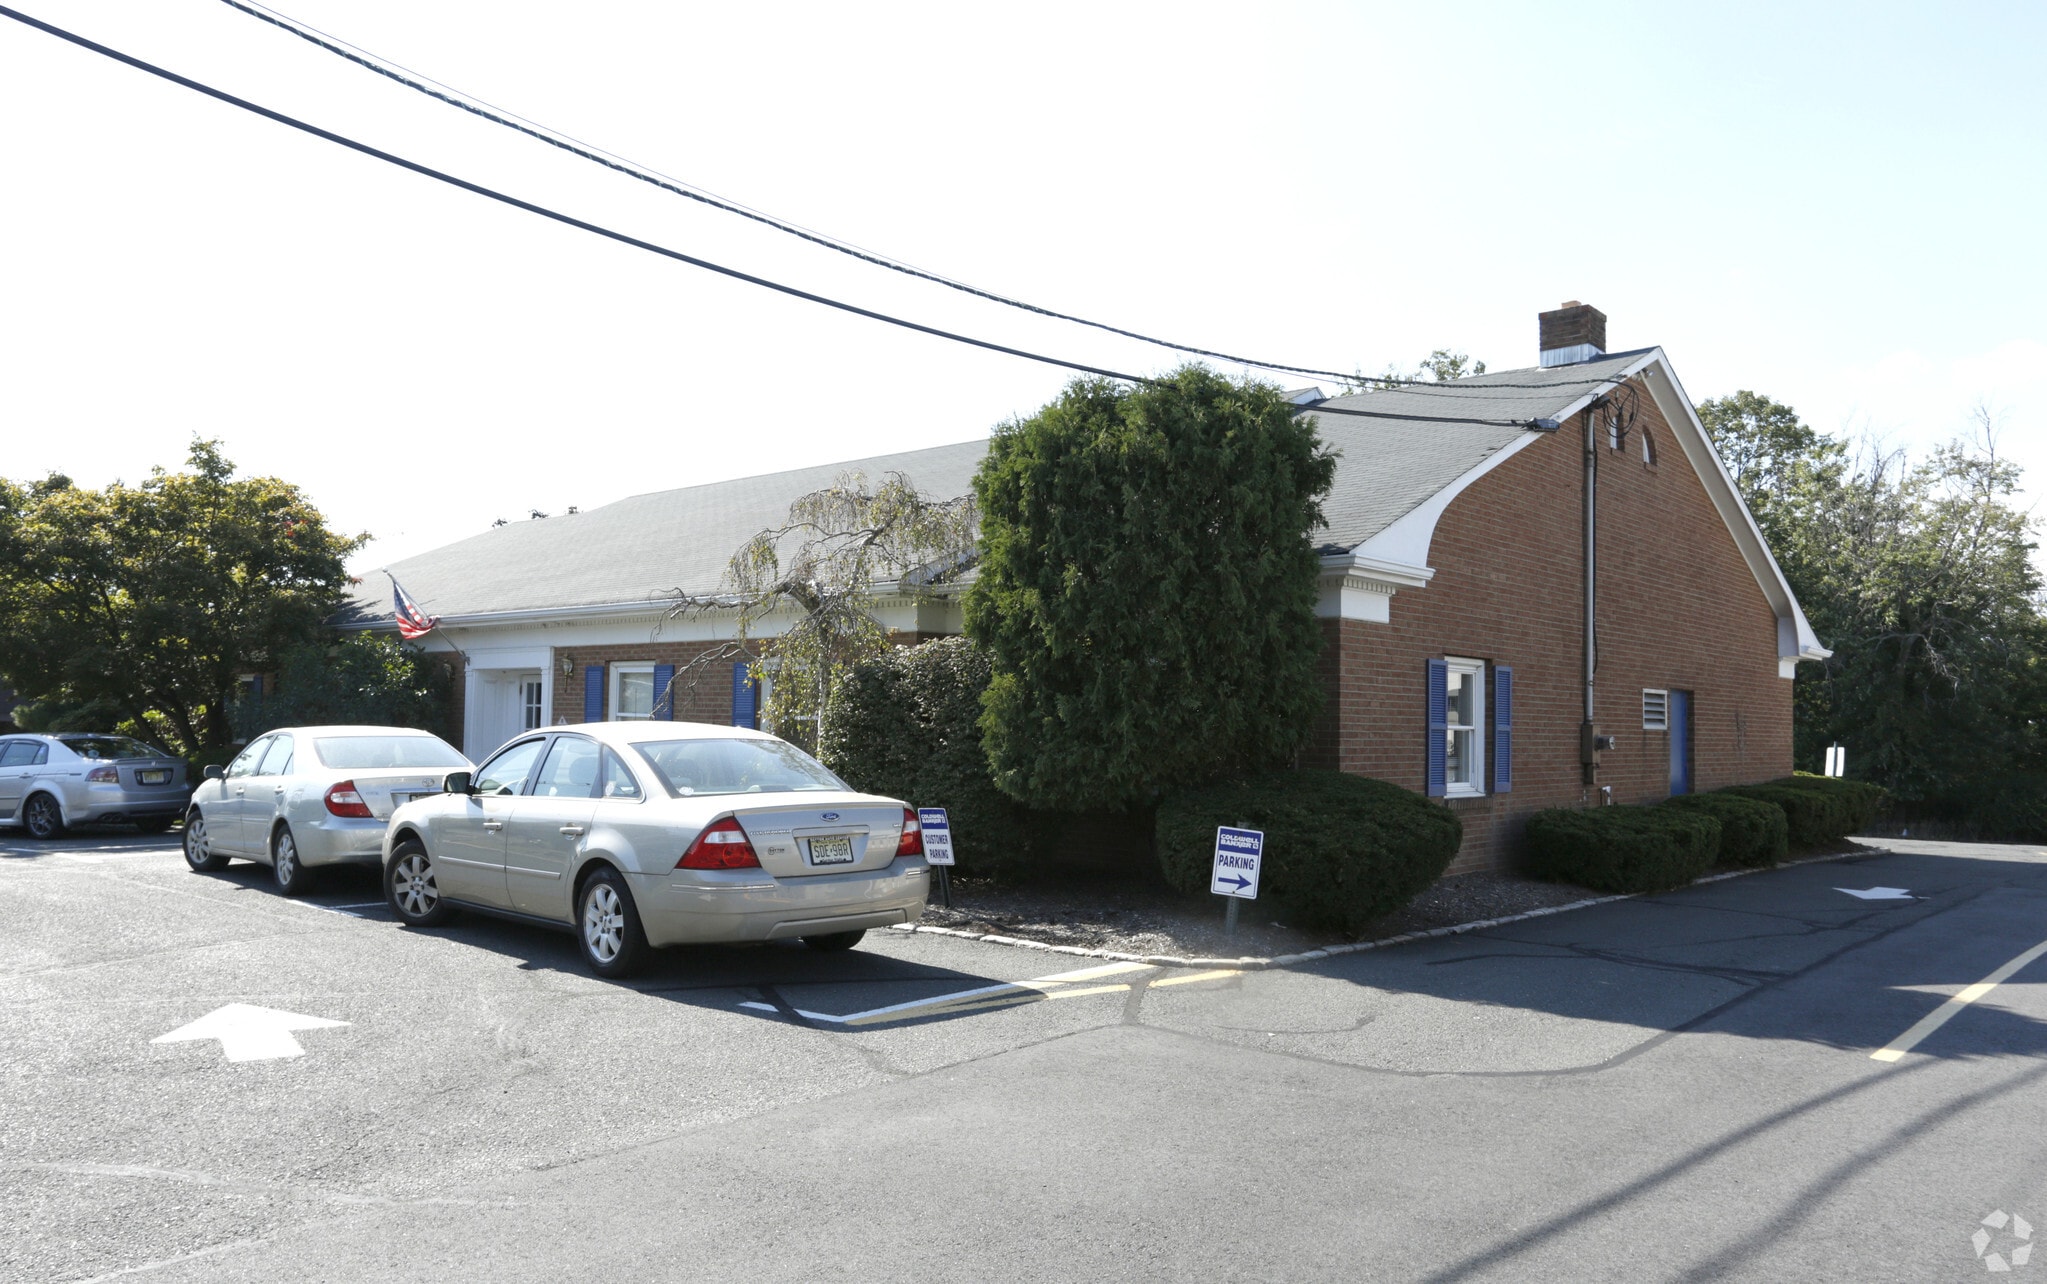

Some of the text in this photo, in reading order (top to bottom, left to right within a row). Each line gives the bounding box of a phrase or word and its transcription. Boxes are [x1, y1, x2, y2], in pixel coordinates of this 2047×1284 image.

[1220, 834, 1259, 844] COLDWELL
[1220, 839, 1252, 848] BANKER
[1218, 855, 1254, 870] PARKING
